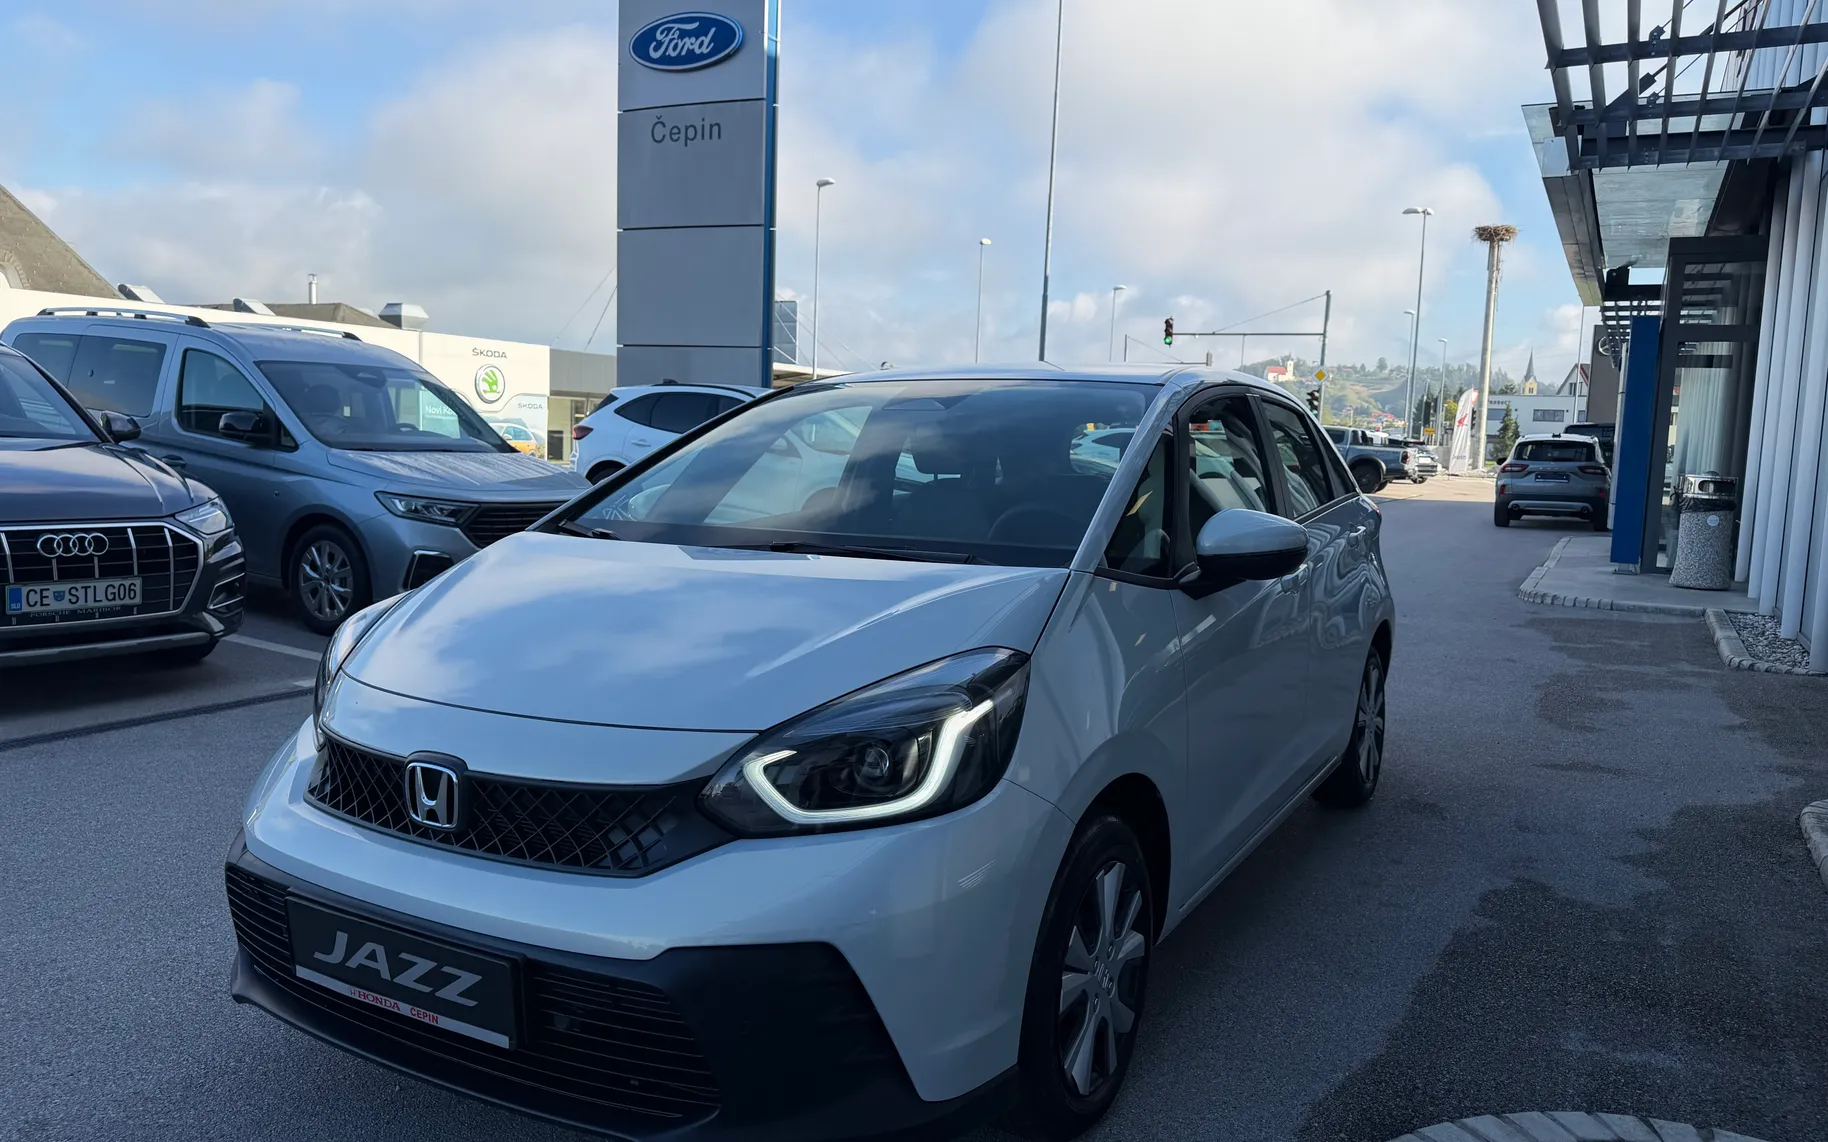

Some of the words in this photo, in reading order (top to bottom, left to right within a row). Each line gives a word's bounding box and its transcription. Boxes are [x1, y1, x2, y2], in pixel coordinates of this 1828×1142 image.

[649, 21, 717, 60] Ford
[651, 115, 722, 147] Čepin
[471, 346, 508, 359] ŠKODA
[425, 404, 442, 415] Novi
[10, 602, 21, 610] SLO
[25, 587, 51, 608] CE
[67, 582, 137, 605] STLG06
[30, 610, 70, 618] PORSCHE
[77, 606, 121, 615] MARIBOR
[313, 930, 483, 1007] JAZZ
[357, 990, 400, 1011] HONDA
[409, 1007, 439, 1025] CEPIN
